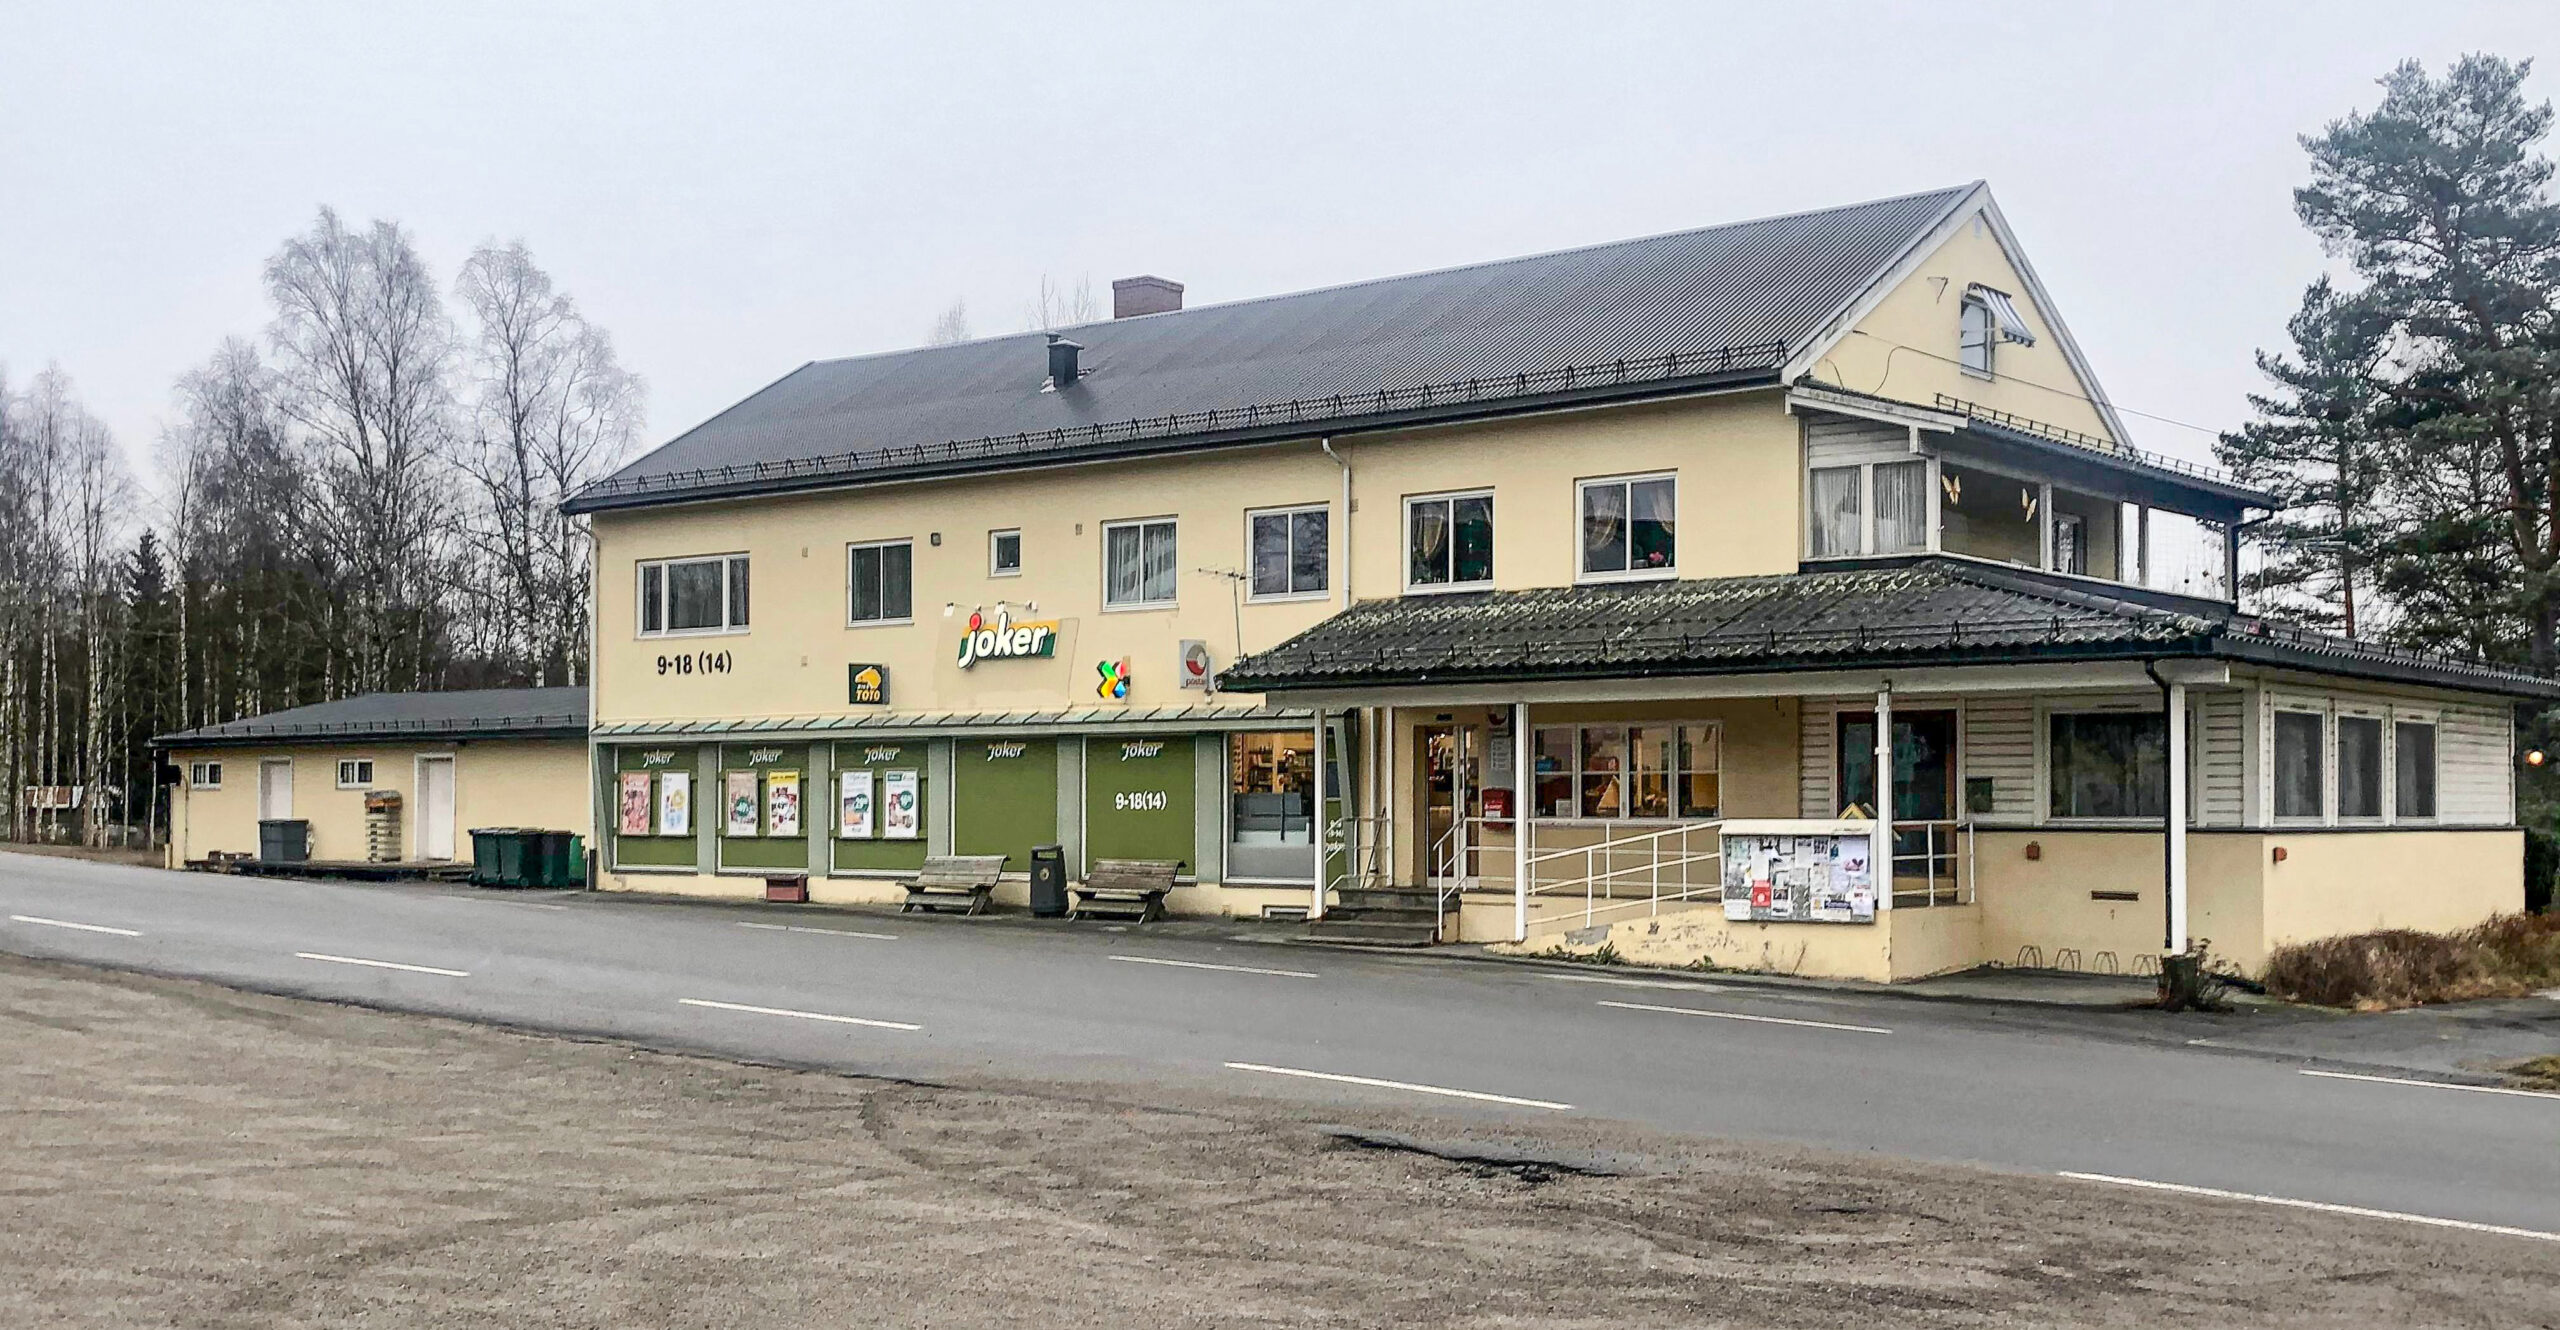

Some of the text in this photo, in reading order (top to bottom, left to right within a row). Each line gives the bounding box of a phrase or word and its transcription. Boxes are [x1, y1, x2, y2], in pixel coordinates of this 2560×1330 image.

[958, 611, 1049, 668] joker
[698, 649, 732, 675] (14)
[856, 689, 881, 702] TOTO
[642, 749, 675, 768] joker
[748, 746, 783, 766] joker
[864, 744, 900, 765] joker
[987, 740, 1026, 762] joker
[1121, 739, 1165, 762] joker
